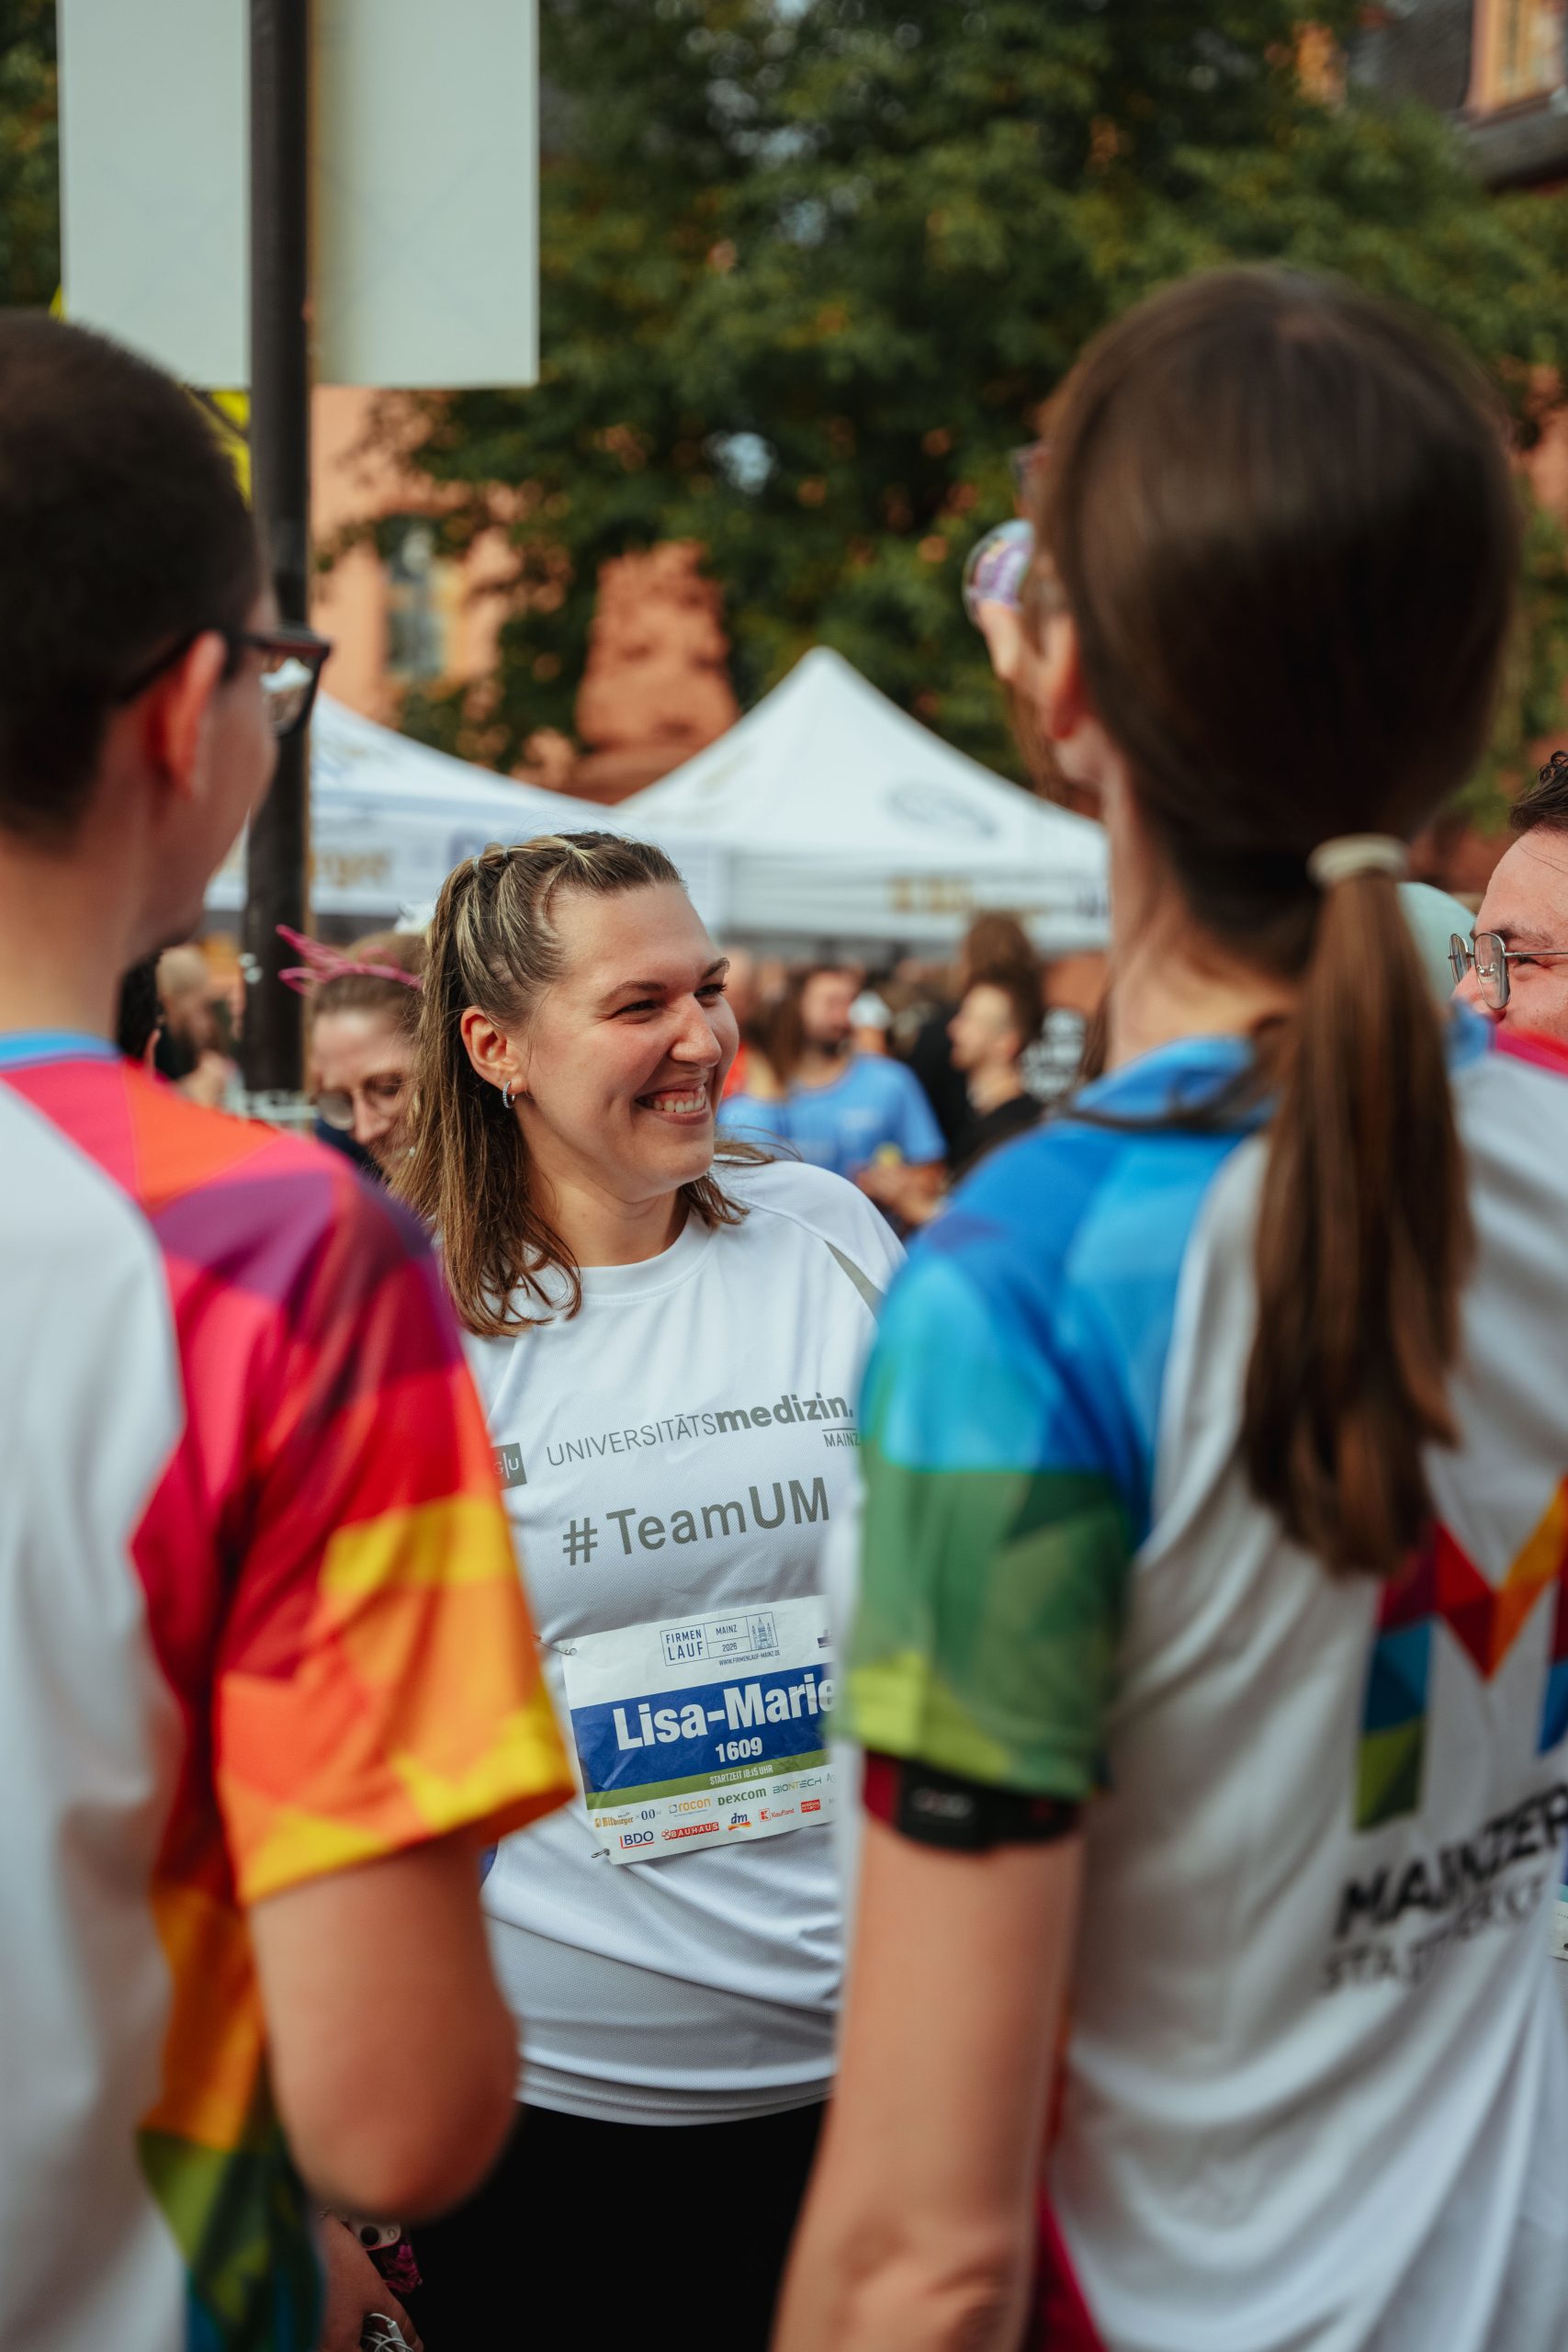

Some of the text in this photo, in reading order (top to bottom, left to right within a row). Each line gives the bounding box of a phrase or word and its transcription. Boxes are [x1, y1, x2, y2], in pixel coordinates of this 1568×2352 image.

[823, 1431, 861, 1448] MAINZ
[666, 1628, 703, 1645] FIRMEN
[716, 1624, 739, 1636] MAINZ
[668, 1641, 703, 1660] LAUF
[613, 1673, 837, 1750] Lisa-Marie
[715, 1736, 763, 1763] 1609
[710, 1771, 742, 1785] STARTZEIT
[760, 1765, 773, 1775] UHR
[679, 1798, 710, 1812] rocon
[731, 1813, 748, 1824] dm
[625, 1831, 653, 1845] BDO
[670, 1822, 719, 1838] BAUHAUS
